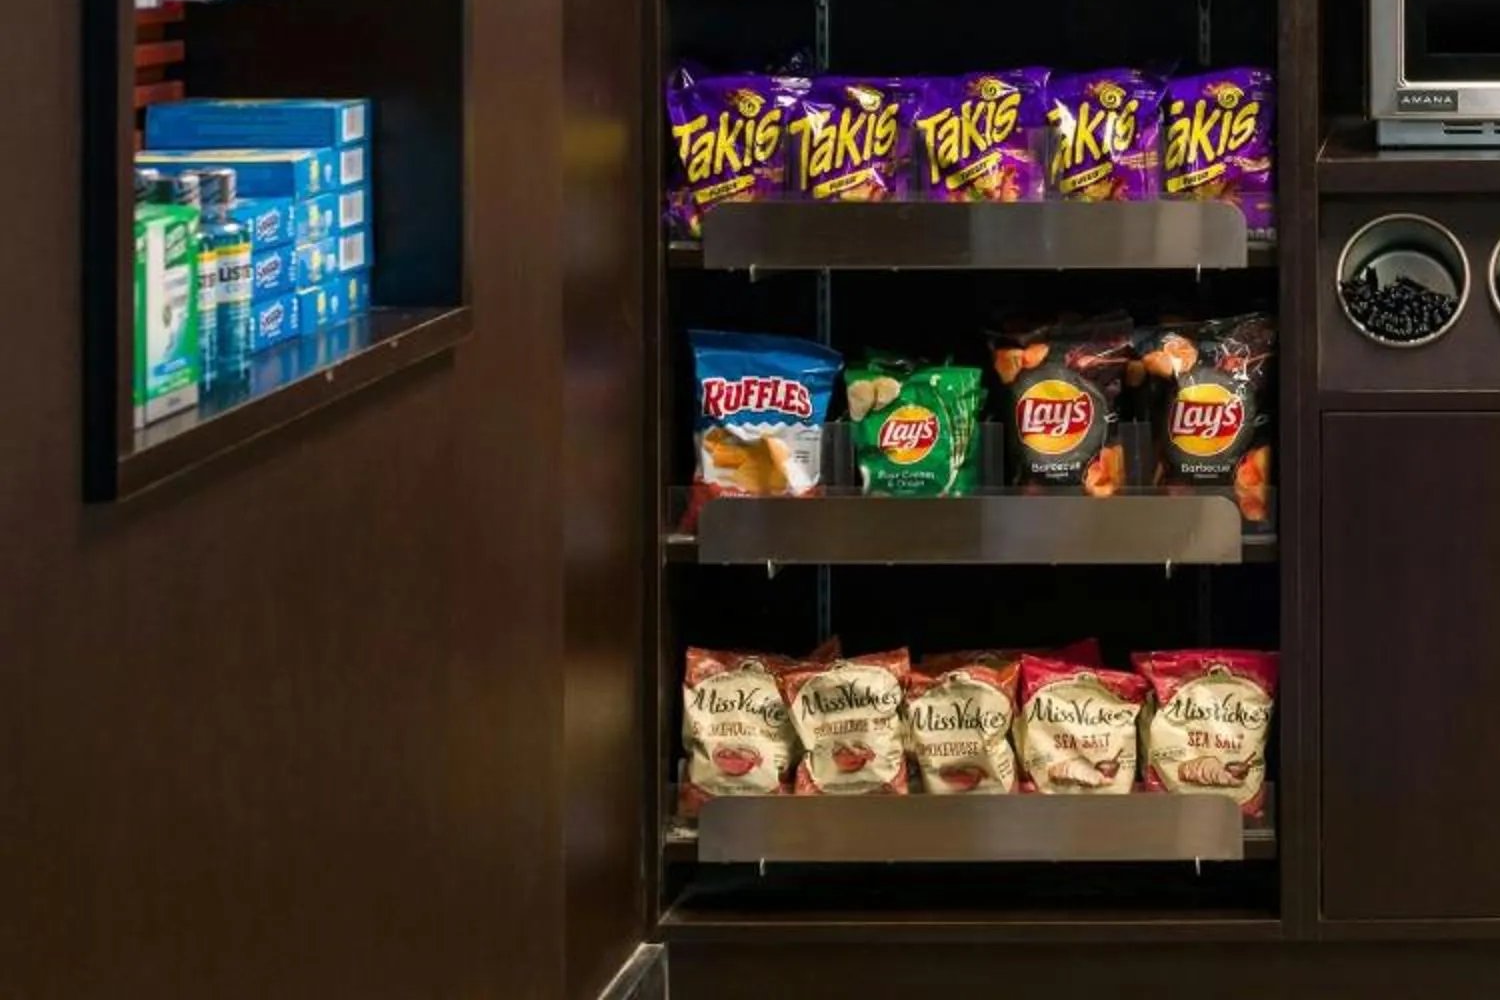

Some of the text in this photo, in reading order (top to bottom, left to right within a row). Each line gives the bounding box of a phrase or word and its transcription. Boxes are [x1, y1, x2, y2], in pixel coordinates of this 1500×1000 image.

[1402, 95, 1453, 105] AMANA
[701, 376, 813, 419] RUFFLES
[1021, 393, 1089, 436] Lay's
[1173, 397, 1241, 438] Lay's
[880, 414, 937, 449] Lay's
[1031, 461, 1081, 473] Barbecue
[1181, 463, 1231, 473] Barbecue
[1028, 698, 1074, 723] Miss
[1054, 734, 1077, 749] SEA
[1188, 732, 1210, 747] SEA
